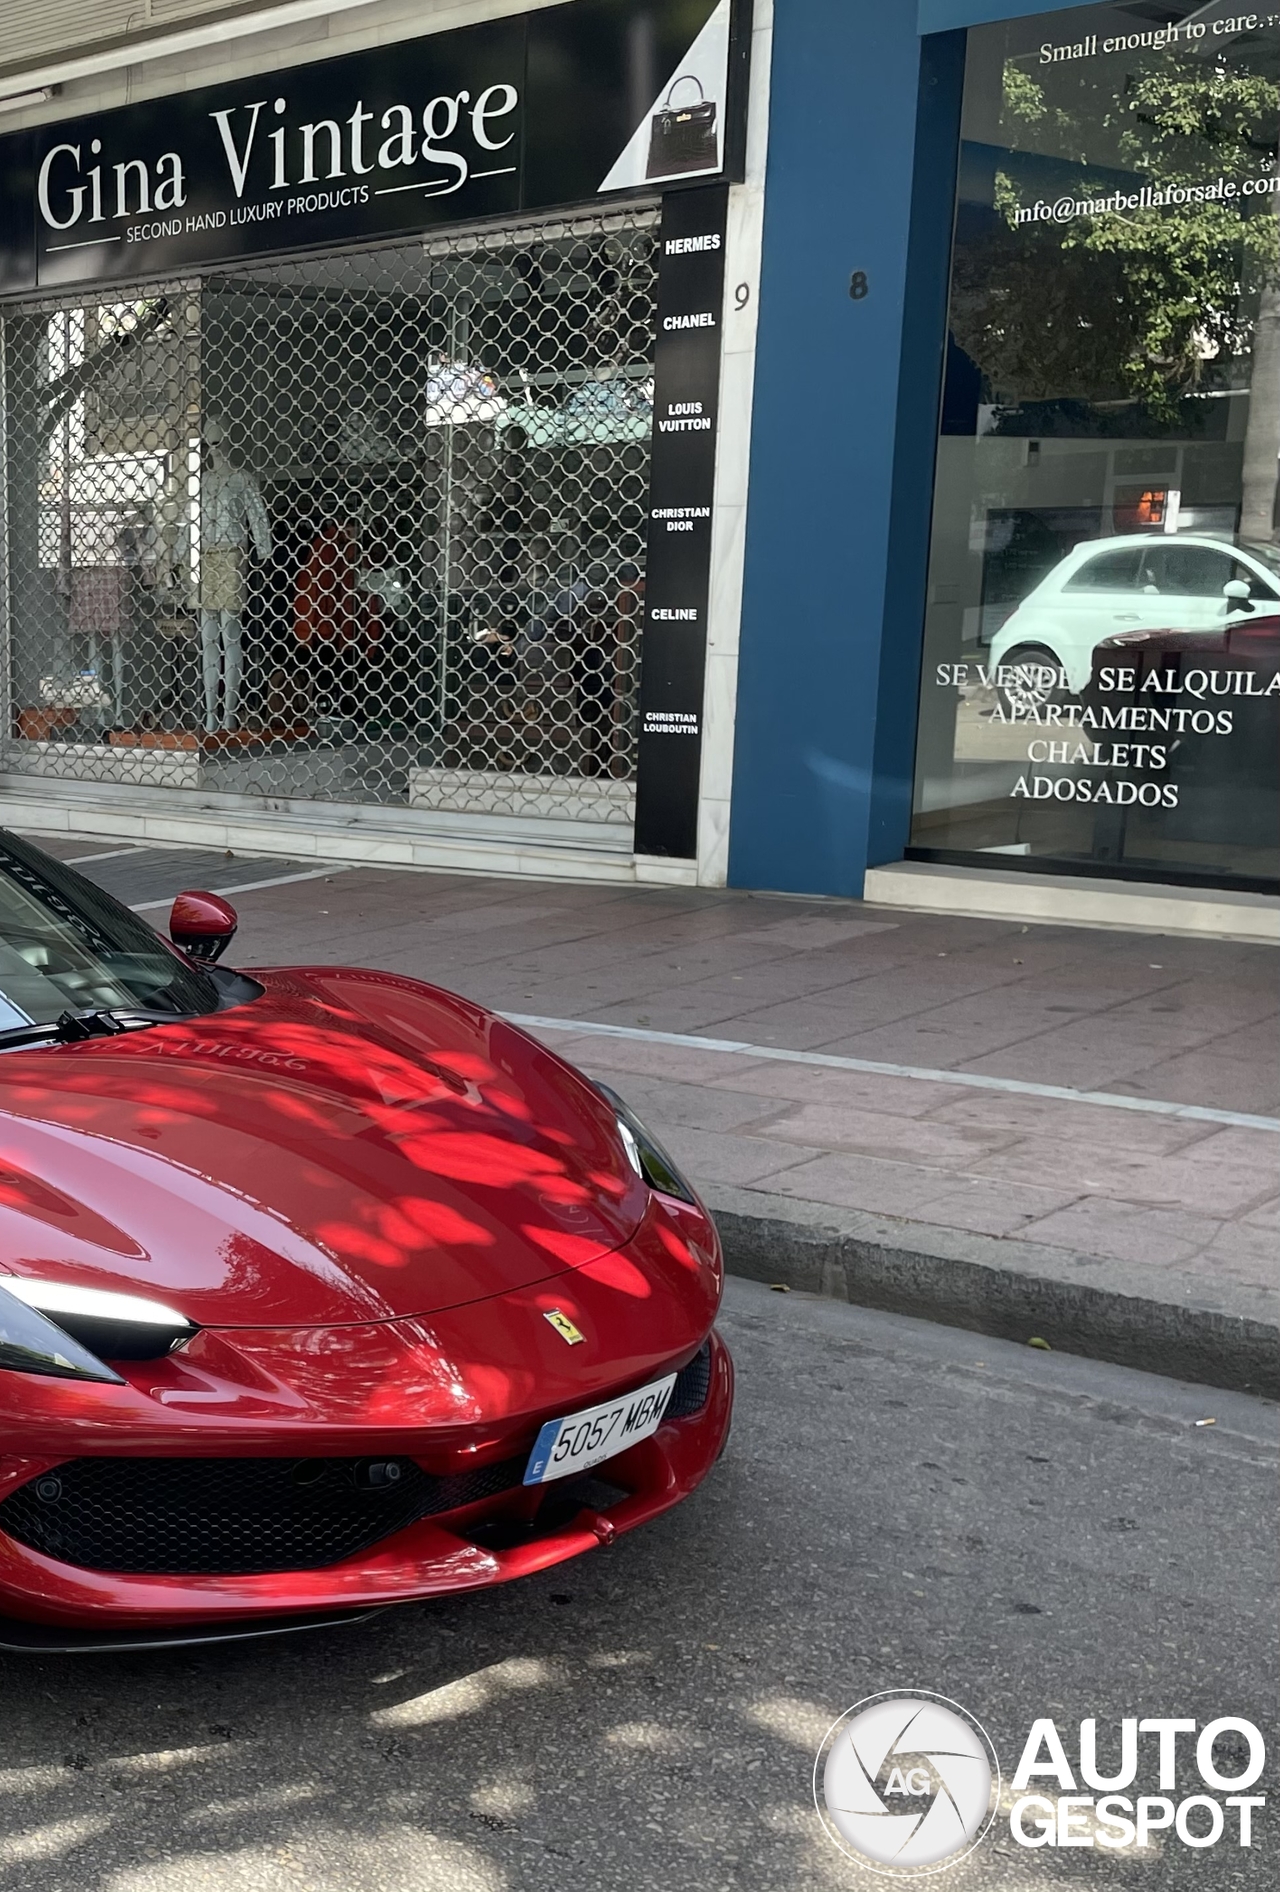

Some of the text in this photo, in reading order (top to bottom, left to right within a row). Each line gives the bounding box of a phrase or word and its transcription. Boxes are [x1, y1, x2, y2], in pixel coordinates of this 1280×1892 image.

[1039, 34, 1097, 64] Small
[1102, 22, 1179, 50] enough
[1186, 21, 1207, 39] to
[37, 83, 519, 230] Gina Vintage
[126, 185, 370, 243] SECOND HAND LUXURY PRODUCTS
[665, 234, 721, 255] HERMES
[734, 281, 750, 311] 9
[849, 271, 869, 300] 8
[663, 312, 716, 330] CHANEL
[668, 402, 703, 415] LOUIS
[658, 417, 711, 432] VUITTON
[651, 507, 710, 519] CHRISTIAN
[666, 521, 694, 531] DIOR
[651, 608, 697, 621] CELINE
[936, 663, 969, 686] SE
[1098, 666, 1136, 692] SE
[643, 723, 699, 735] LOUBOUTIN
[645, 712, 697, 723] CHRISTIAN
[987, 702, 1233, 735] APARTAMENTOS
[1027, 739, 1167, 770] CHALETS
[1009, 775, 1179, 808] ADOSADOS
[553, 1407, 625, 1463] 5057
[532, 1460, 544, 1475] E
